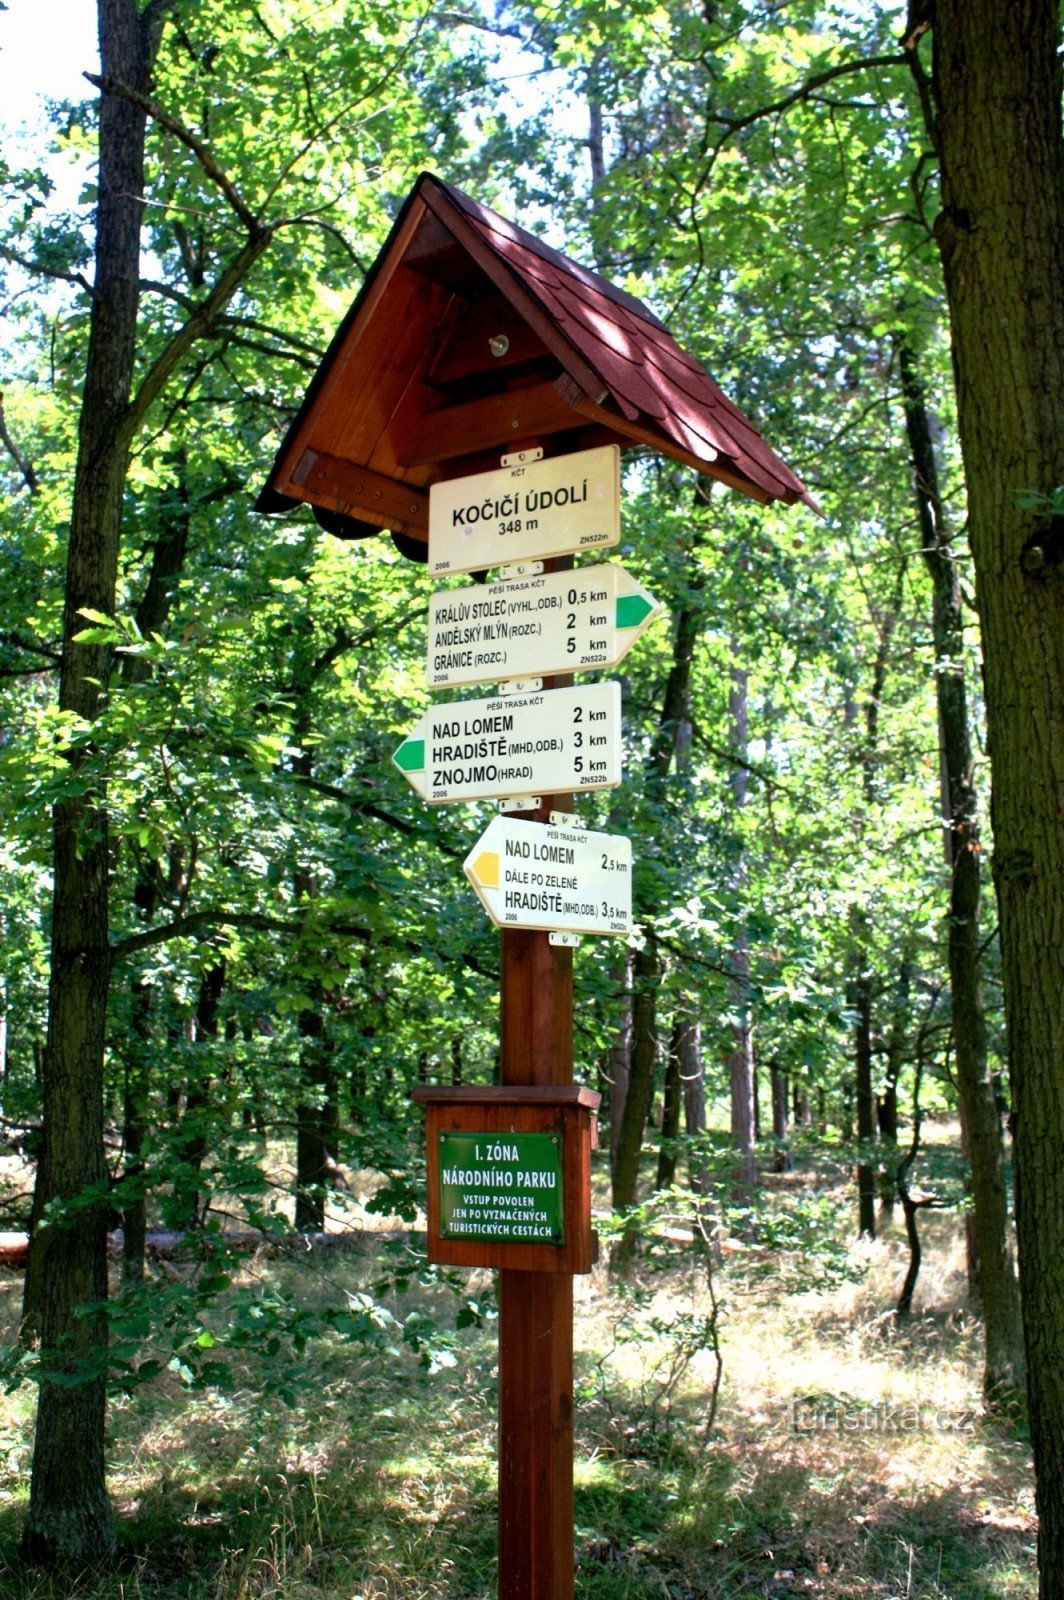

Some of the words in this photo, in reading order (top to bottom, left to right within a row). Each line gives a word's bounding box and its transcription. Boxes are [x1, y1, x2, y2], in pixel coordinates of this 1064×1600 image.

[511, 468, 525, 478] KČT
[452, 493, 519, 526] KOČIČÍ
[526, 479, 587, 512] ÚDOLÍ
[498, 520, 521, 535] 348
[526, 519, 538, 530] m
[580, 534, 608, 544] ZN522m
[435, 562, 450, 570] 2006
[506, 583, 530, 592] TRASA
[531, 580, 545, 588] KČT
[472, 599, 506, 620] STOLEC
[567, 589, 587, 605] 0,5
[590, 591, 607, 601] km
[435, 623, 481, 648] ANDĚLSKÝ
[483, 620, 508, 640] MLÝN
[566, 613, 576, 629] 2
[590, 616, 607, 626] km
[434, 651, 472, 670] GRÁNICE
[474, 651, 507, 667] (ROZC.)
[566, 638, 576, 653] 5
[590, 640, 607, 651] km
[580, 655, 607, 664] ZN522a
[504, 699, 528, 708] TRASA
[529, 697, 543, 706] KČT
[433, 723, 460, 739] NAD
[465, 715, 514, 736] LOMEM
[573, 707, 582, 723] 2
[589, 710, 606, 722] km
[432, 737, 507, 763] HRADIŠTĚ
[574, 732, 583, 748] 3
[590, 735, 607, 746] km
[574, 756, 583, 772] 5
[590, 760, 607, 772] km
[580, 775, 607, 784] ZN522b
[560, 833, 576, 842] TRASA
[506, 840, 530, 858] NAD
[534, 844, 574, 864] LOMEM
[601, 854, 614, 871] 2,5
[616, 861, 627, 872] km
[505, 868, 529, 884] DÁLE
[531, 874, 543, 885] PO
[546, 875, 577, 889] ZELENÉ
[505, 891, 562, 912] HRADIŠTĚ
[601, 901, 614, 920] 3,5
[616, 908, 627, 919] km
[475, 1145, 483, 1160] I.
[486, 1141, 519, 1161] ZÓNA
[443, 1165, 512, 1187] NÁRODNÍHO
[517, 1172, 555, 1188] PARKU
[463, 1195, 490, 1205] VSTUP
[493, 1196, 534, 1206] POVOLEN
[453, 1209, 466, 1218] JEN
[470, 1209, 480, 1218] PO
[483, 1208, 547, 1221] VYZNAČENÝCH
[450, 1222, 509, 1234] TURISTICKÝCH
[513, 1224, 552, 1236] CESTÁCH
